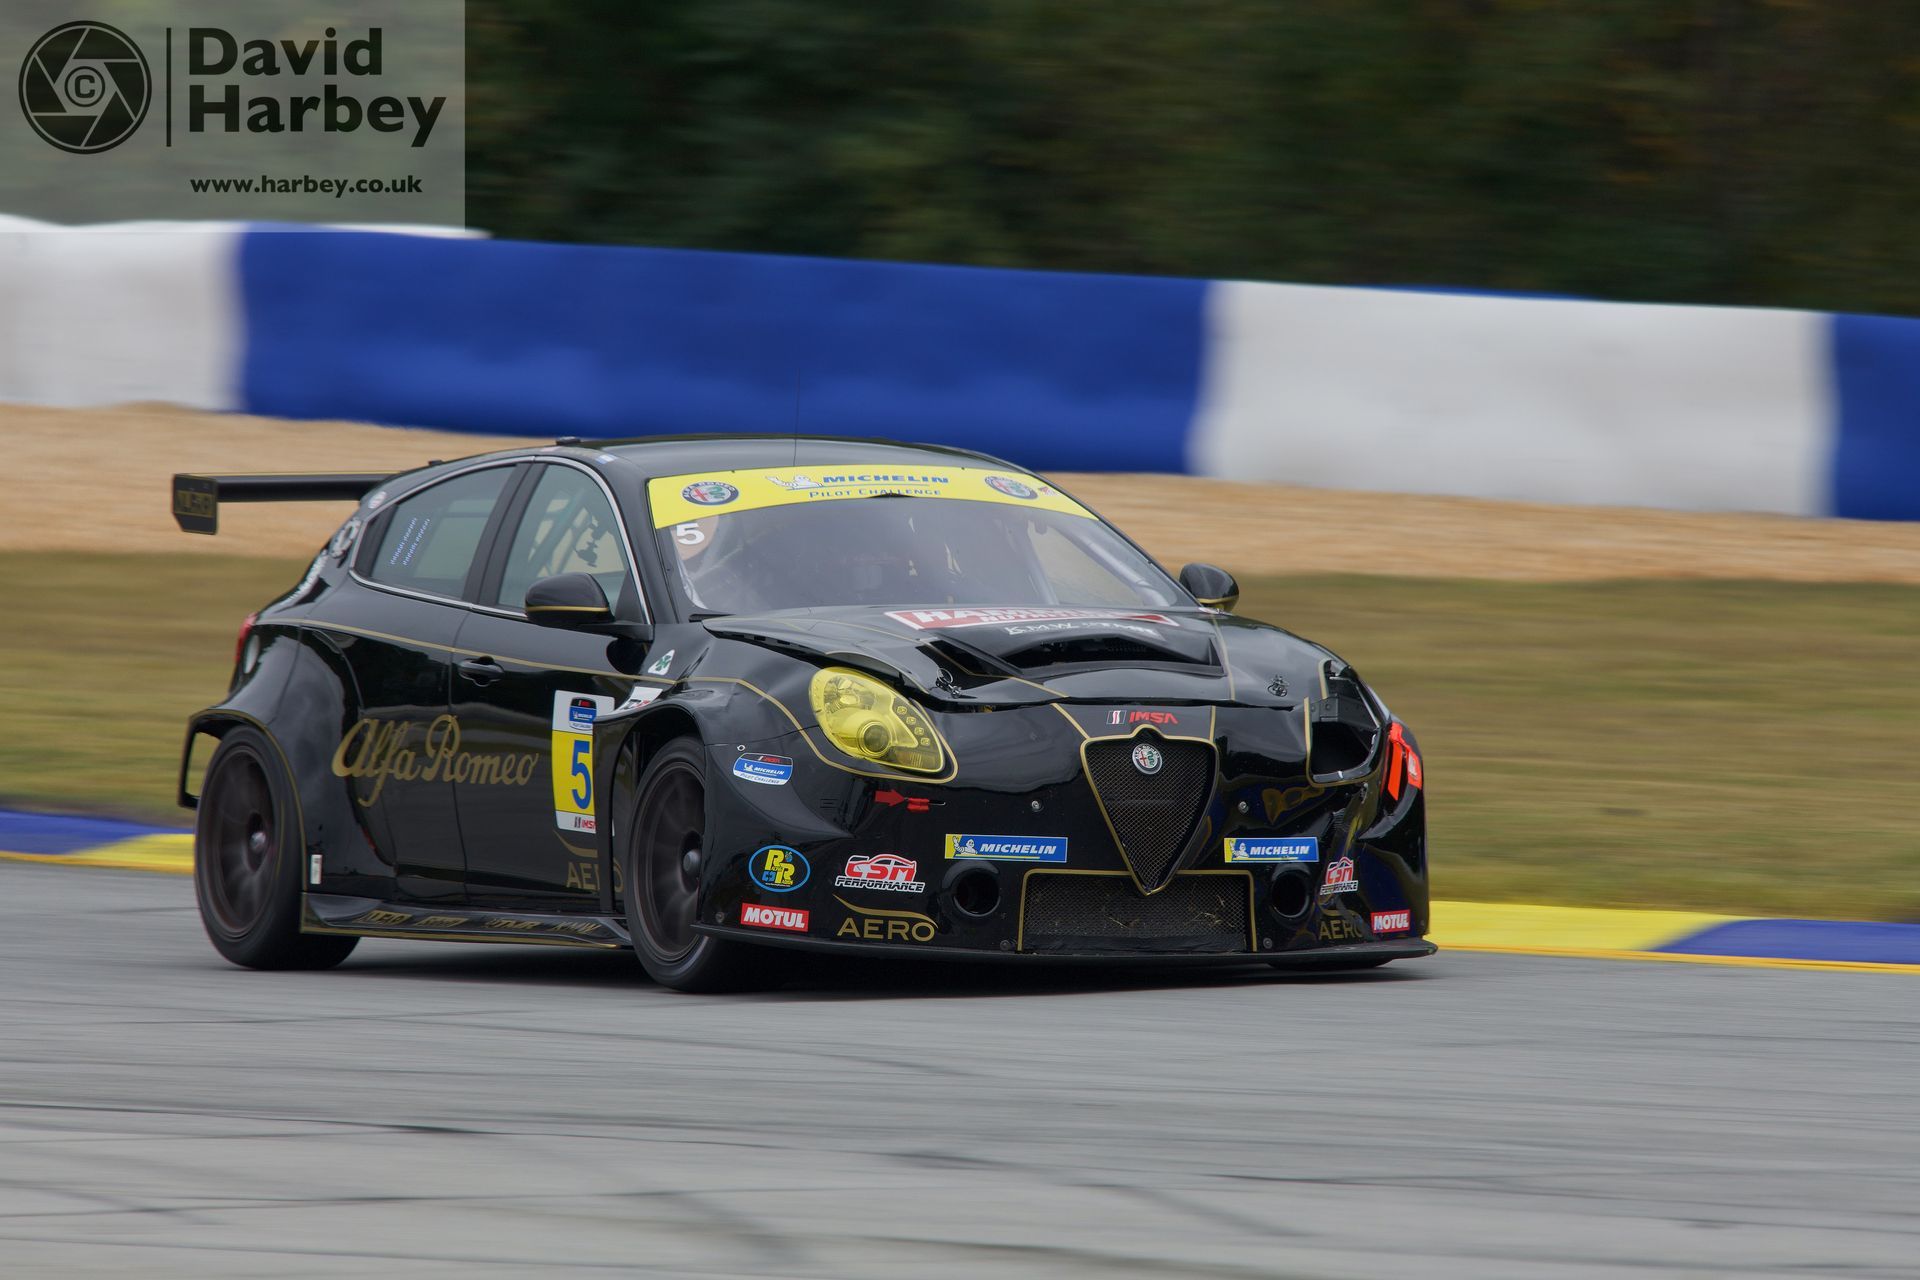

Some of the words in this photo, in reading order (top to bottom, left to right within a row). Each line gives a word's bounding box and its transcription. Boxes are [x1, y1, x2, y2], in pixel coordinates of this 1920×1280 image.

[822, 474, 949, 484] MICHELIN
[676, 522, 705, 545] 5
[1129, 711, 1179, 725] IMSA
[331, 718, 422, 808] Alfa
[421, 714, 540, 786] Romeo
[571, 740, 592, 810] 5
[754, 766, 785, 775] MICHELIN
[980, 843, 1057, 855] MICHELIN
[1250, 845, 1311, 856] MICHELIN
[836, 877, 924, 892] PERFORMANCE
[743, 906, 805, 929] MOTUL
[1373, 913, 1410, 931] MOTUL
[837, 917, 935, 942] AERO
